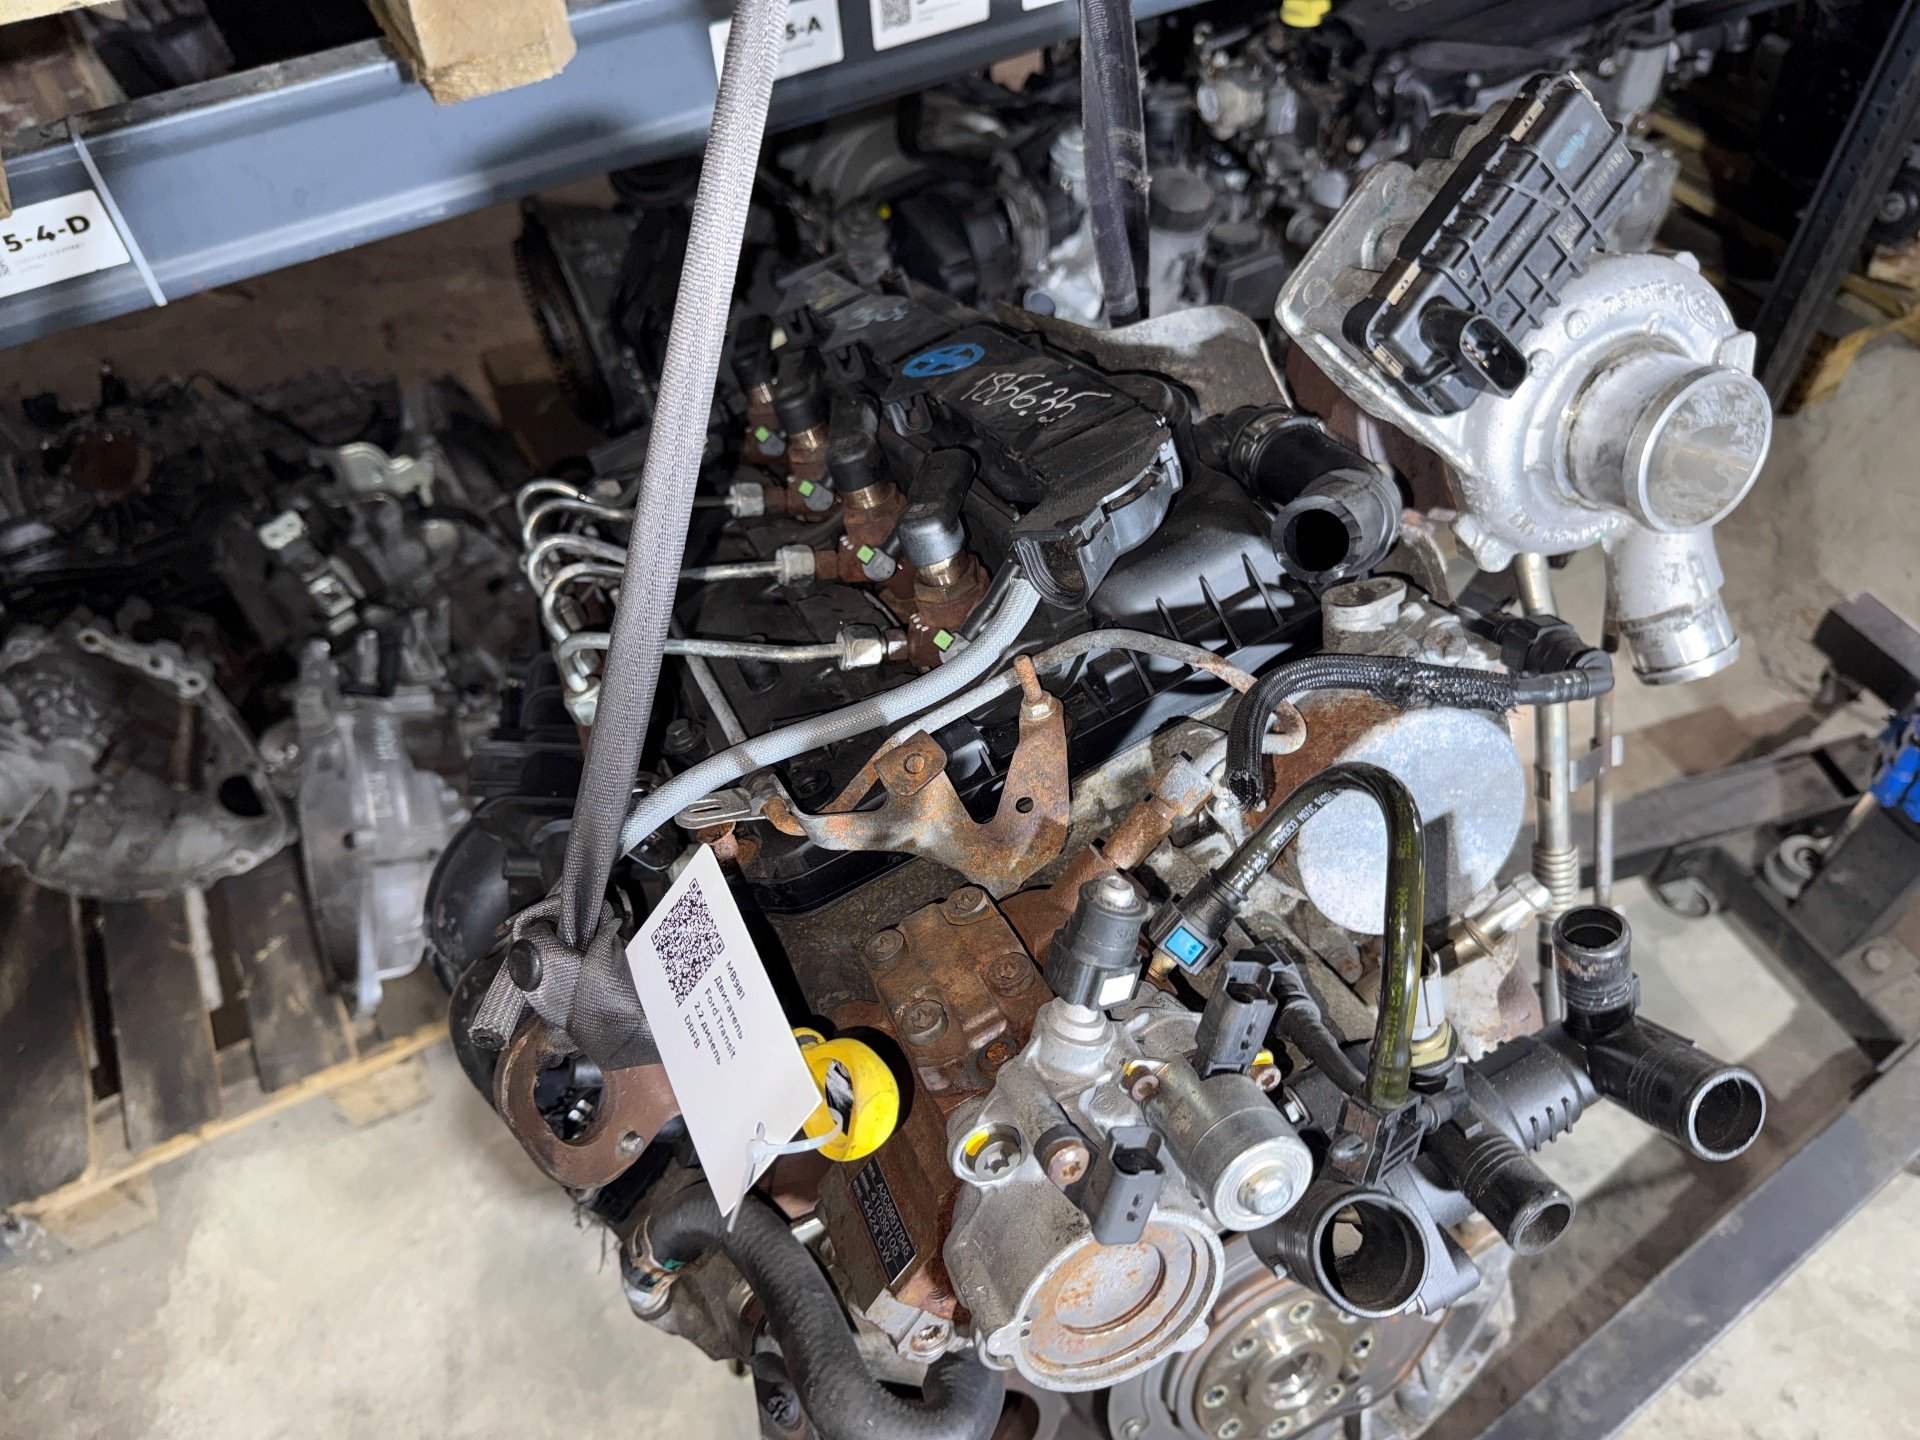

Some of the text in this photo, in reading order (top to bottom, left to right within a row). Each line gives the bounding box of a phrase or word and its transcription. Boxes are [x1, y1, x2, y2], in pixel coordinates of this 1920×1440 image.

[3, 215, 91, 252] 5-4-D
[714, 975, 743, 1040] Двигатель
[725, 960, 746, 1000] MB981
[694, 1001, 721, 1066] 2.2 дизель
[704, 987, 736, 1060] Ford Transit
[863, 1200, 880, 1234] 4424
[878, 1235, 903, 1263] CW
[870, 1192, 900, 1257] 41039105
